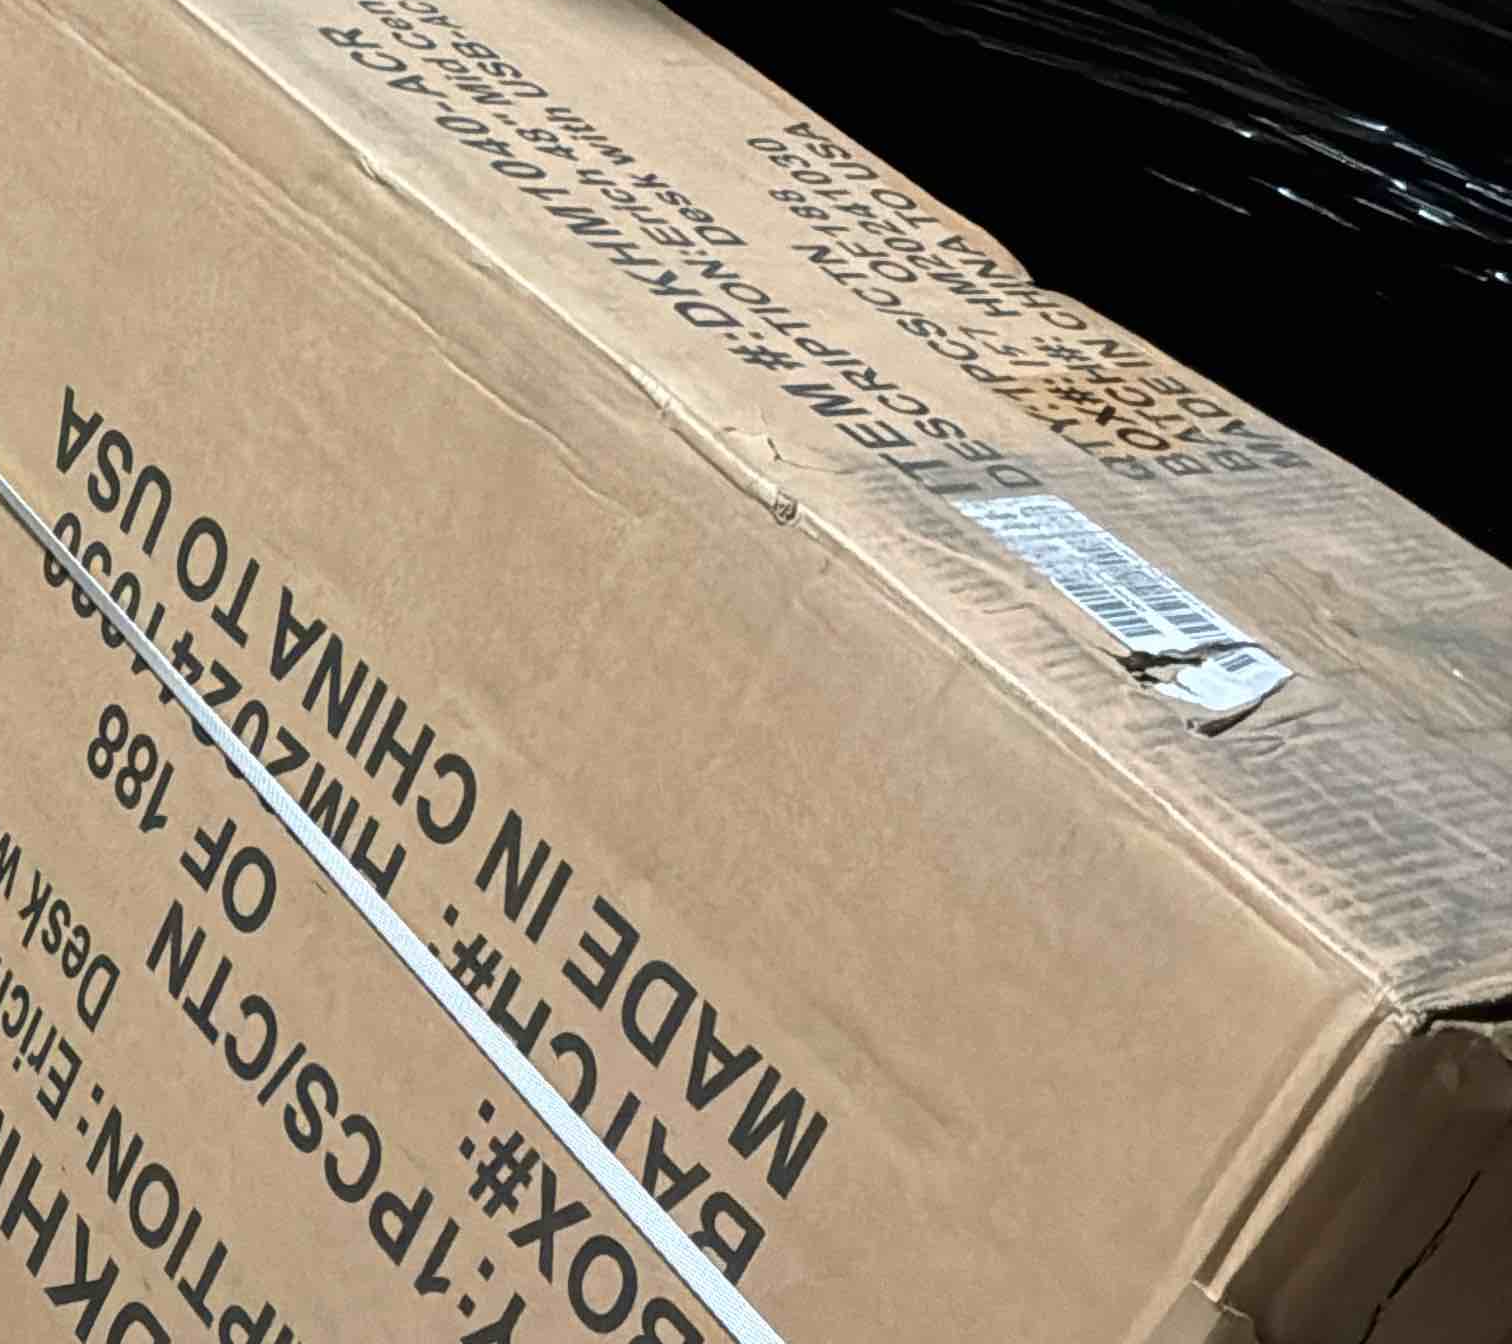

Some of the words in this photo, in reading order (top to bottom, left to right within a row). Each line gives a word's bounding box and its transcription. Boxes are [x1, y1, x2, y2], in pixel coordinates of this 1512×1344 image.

[422, 56, 512, 109] Mid
[544, 105, 635, 166] with
[632, 171, 748, 247] Desk
[783, 122, 880, 182] USA
[873, 188, 943, 228] TO
[746, 136, 1021, 318] HM20241030
[936, 235, 1088, 332] CHINA
[791, 242, 1158, 482] QTY:1PCS/CTN
[1031, 336, 1260, 472] BATCH#:
[1082, 339, 1154, 370] IN
[57, 387, 171, 556] USA
[781, 384, 980, 496] ITEM
[1139, 375, 1313, 469] MADE
[177, 518, 259, 647] TO
[88, 705, 173, 832] 188
[271, 587, 476, 844] CHINA
[181, 819, 276, 932] OF
[476, 810, 572, 942] IN
[19, 871, 120, 1032] Desk
[563, 896, 827, 1199] MADE
